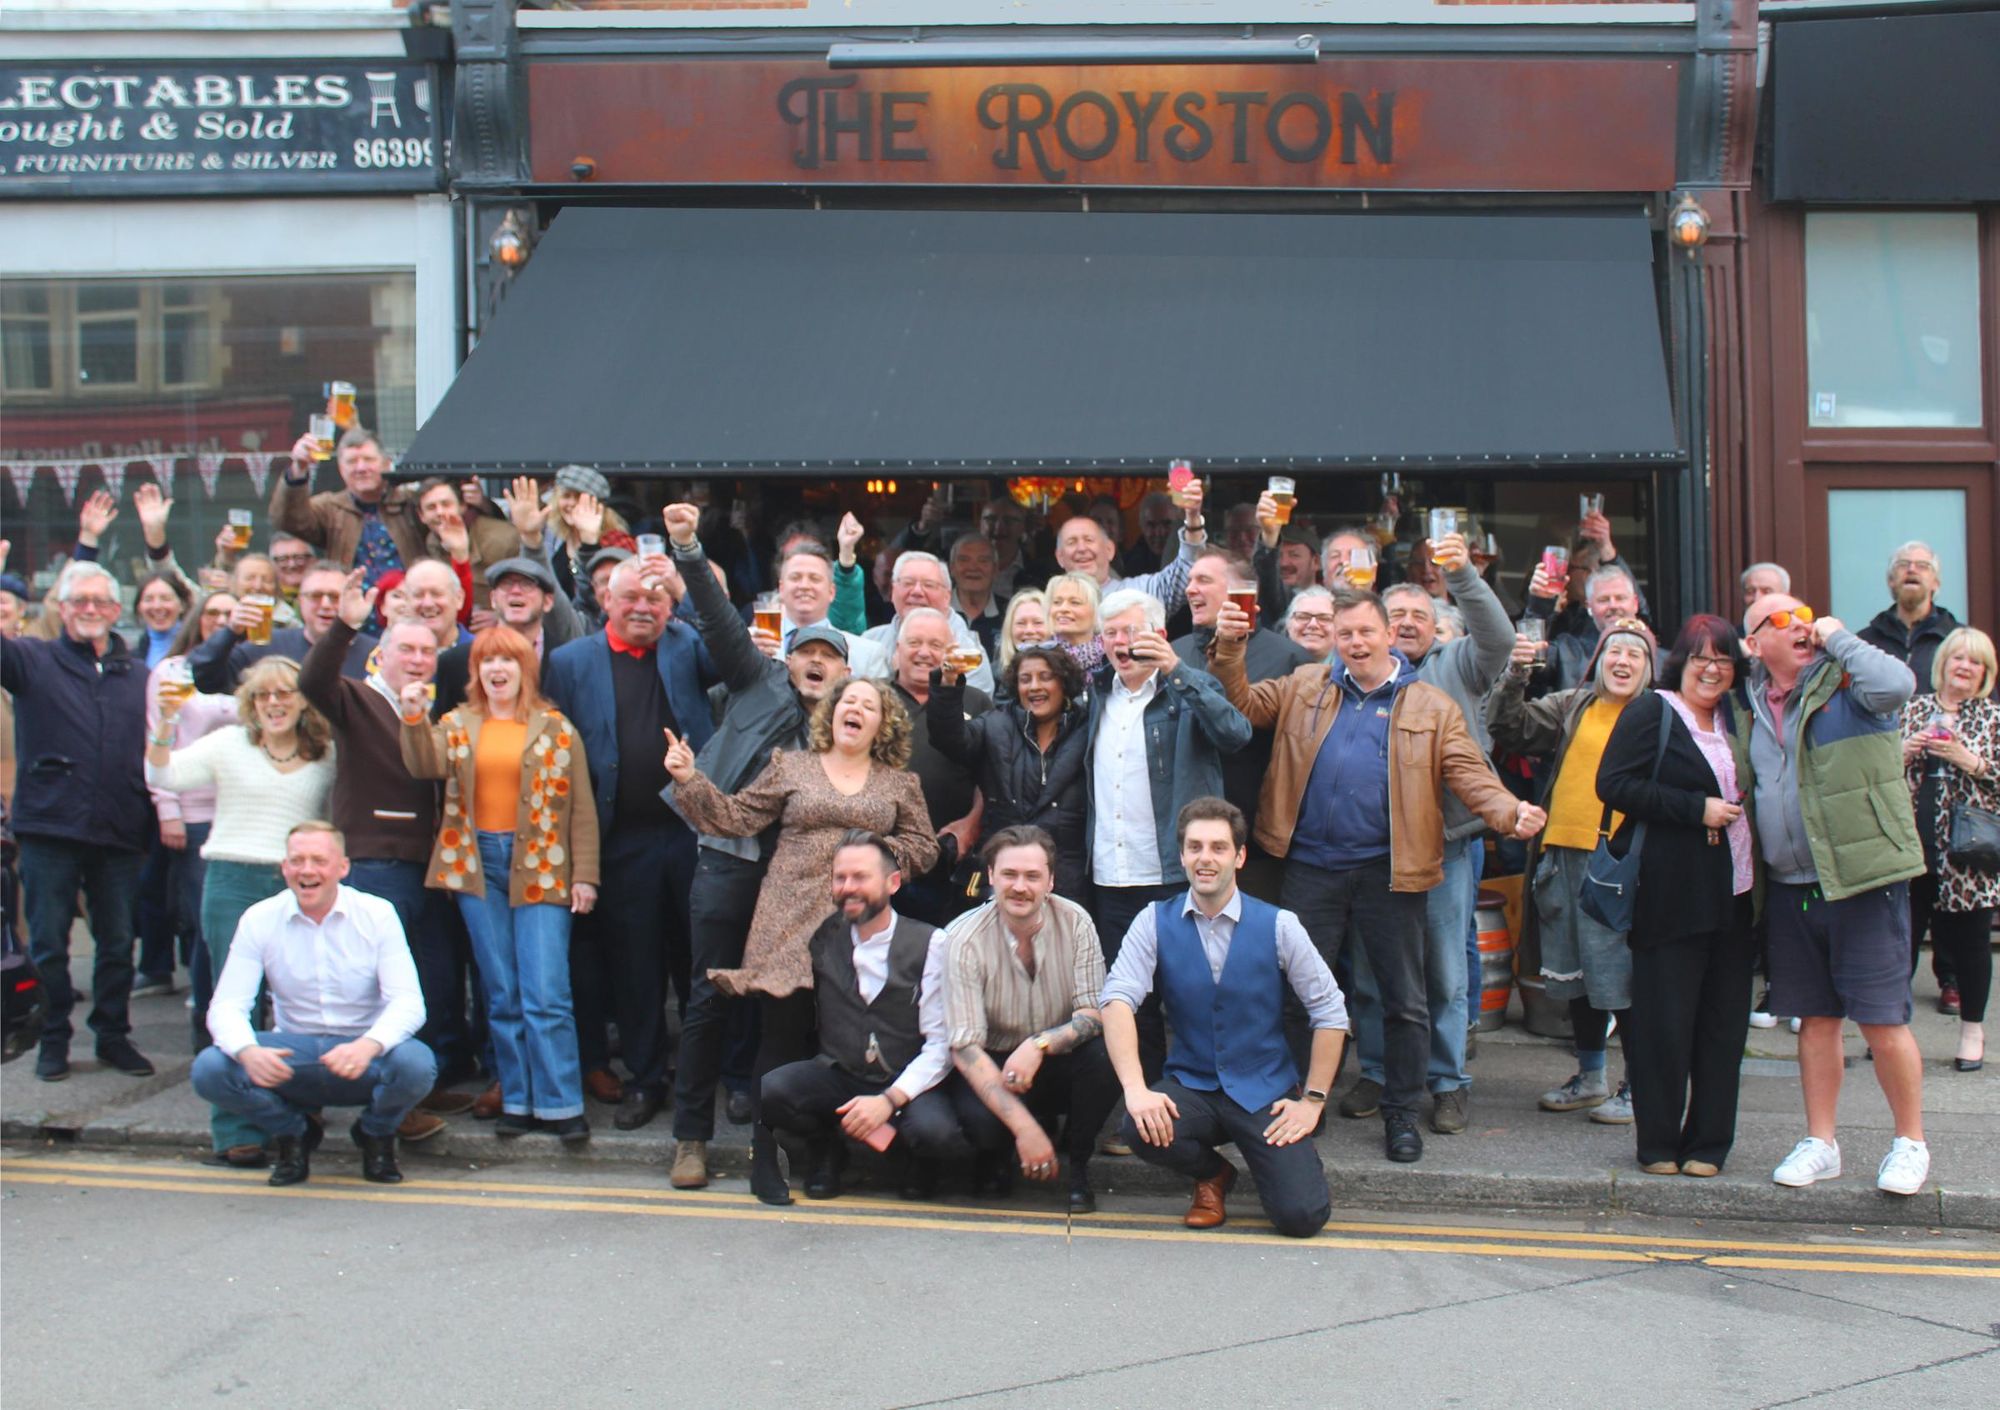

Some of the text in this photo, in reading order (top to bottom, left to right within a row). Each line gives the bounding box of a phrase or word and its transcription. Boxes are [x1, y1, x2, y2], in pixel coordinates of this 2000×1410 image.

[139, 112, 179, 141] &
[193, 111, 295, 141] Sold
[777, 73, 1397, 182] THE ROYSTON
[14, 150, 196, 174] FURNITURE
[201, 150, 225, 171] &
[231, 150, 339, 171] SILVER
